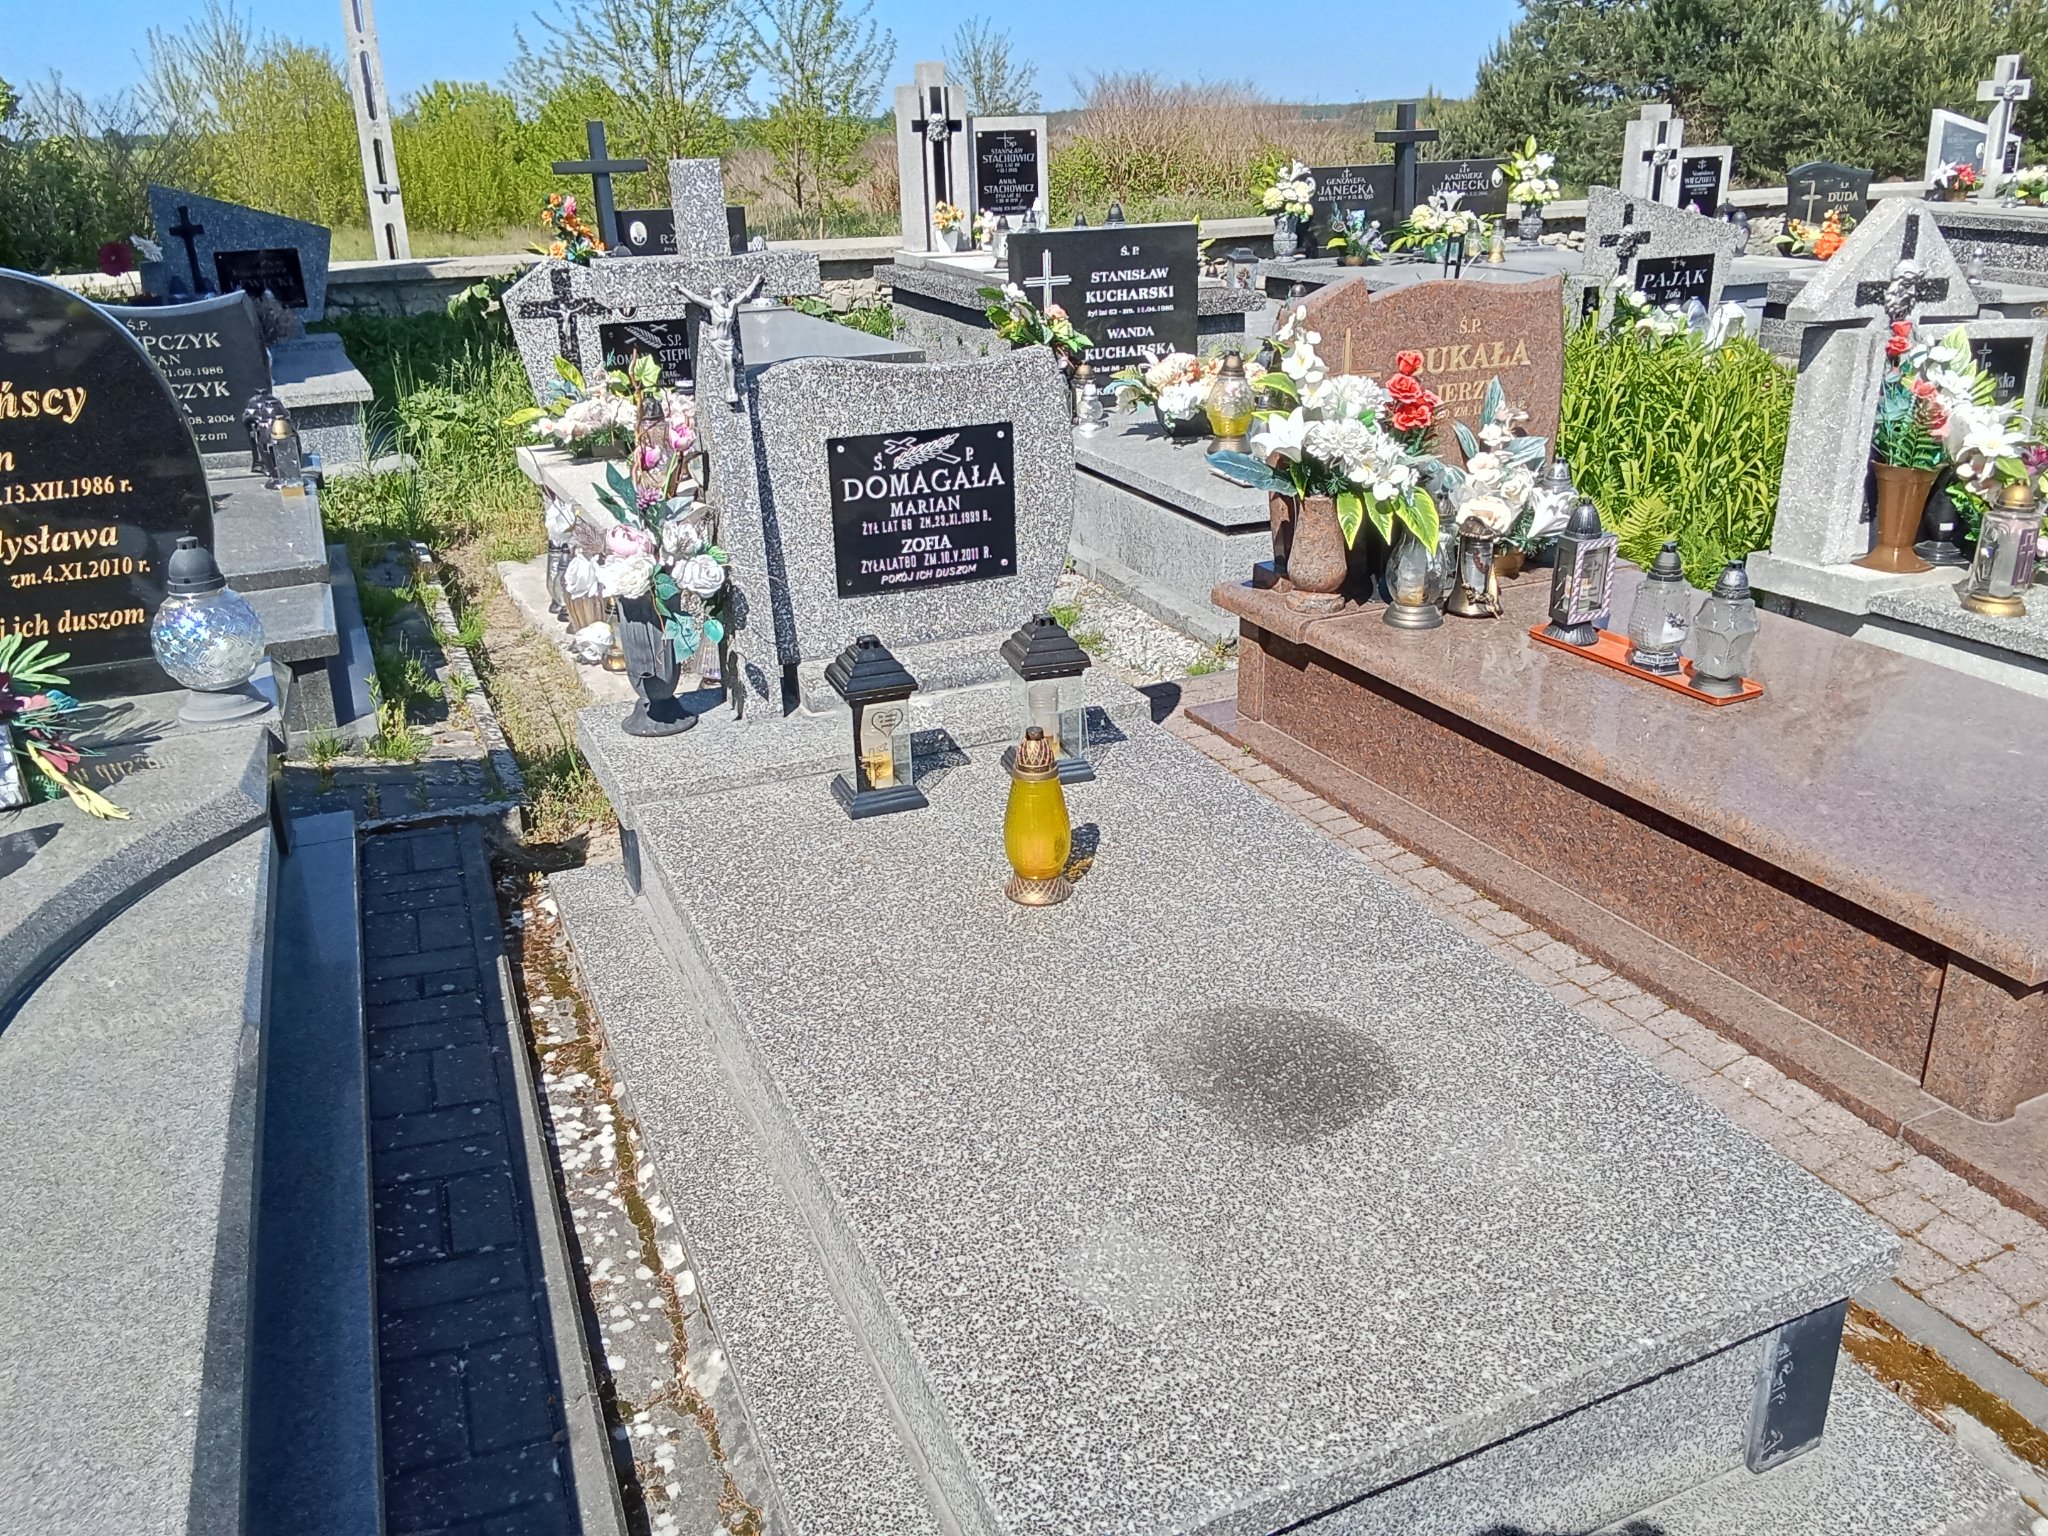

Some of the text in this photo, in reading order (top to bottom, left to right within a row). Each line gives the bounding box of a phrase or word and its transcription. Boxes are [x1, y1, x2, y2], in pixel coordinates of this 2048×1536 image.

[982, 153, 1035, 164] STACHOWICZ
[1326, 177, 1366, 186] GENOWEFA
[1437, 179, 1489, 191] JANECKI
[1444, 172, 1483, 181] KAZIMIERZ
[983, 184, 1035, 195] STACHOWICZ
[1317, 184, 1374, 196] JANECKA
[1827, 191, 1859, 203] DUDA
[1091, 266, 1169, 283] STANISŁAW
[1640, 268, 1708, 289] PAJĄK
[1085, 285, 1174, 304] KUCHARSKI
[1665, 288, 1681, 300] Zofia
[1106, 325, 1155, 340] WANDA
[1459, 316, 1481, 334] Ś.P.
[136, 332, 222, 351] PCZYK
[1084, 342, 1176, 361] KUCHARSKA
[1416, 338, 1531, 375] UKAŁA
[120, 479, 133, 493] r.
[842, 462, 1005, 502] DOMAGAŁA
[890, 495, 961, 518] MARIAN
[862, 521, 880, 535] ŻYŁ
[882, 521, 898, 533] LAT
[901, 534, 952, 554] ZOFIA
[11, 556, 151, 589] zm.4.XI.2010 r.
[881, 563, 978, 585] POKÓJ ICH DUSZOM
[13, 613, 50, 637] ich
[58, 607, 145, 633] duszom
